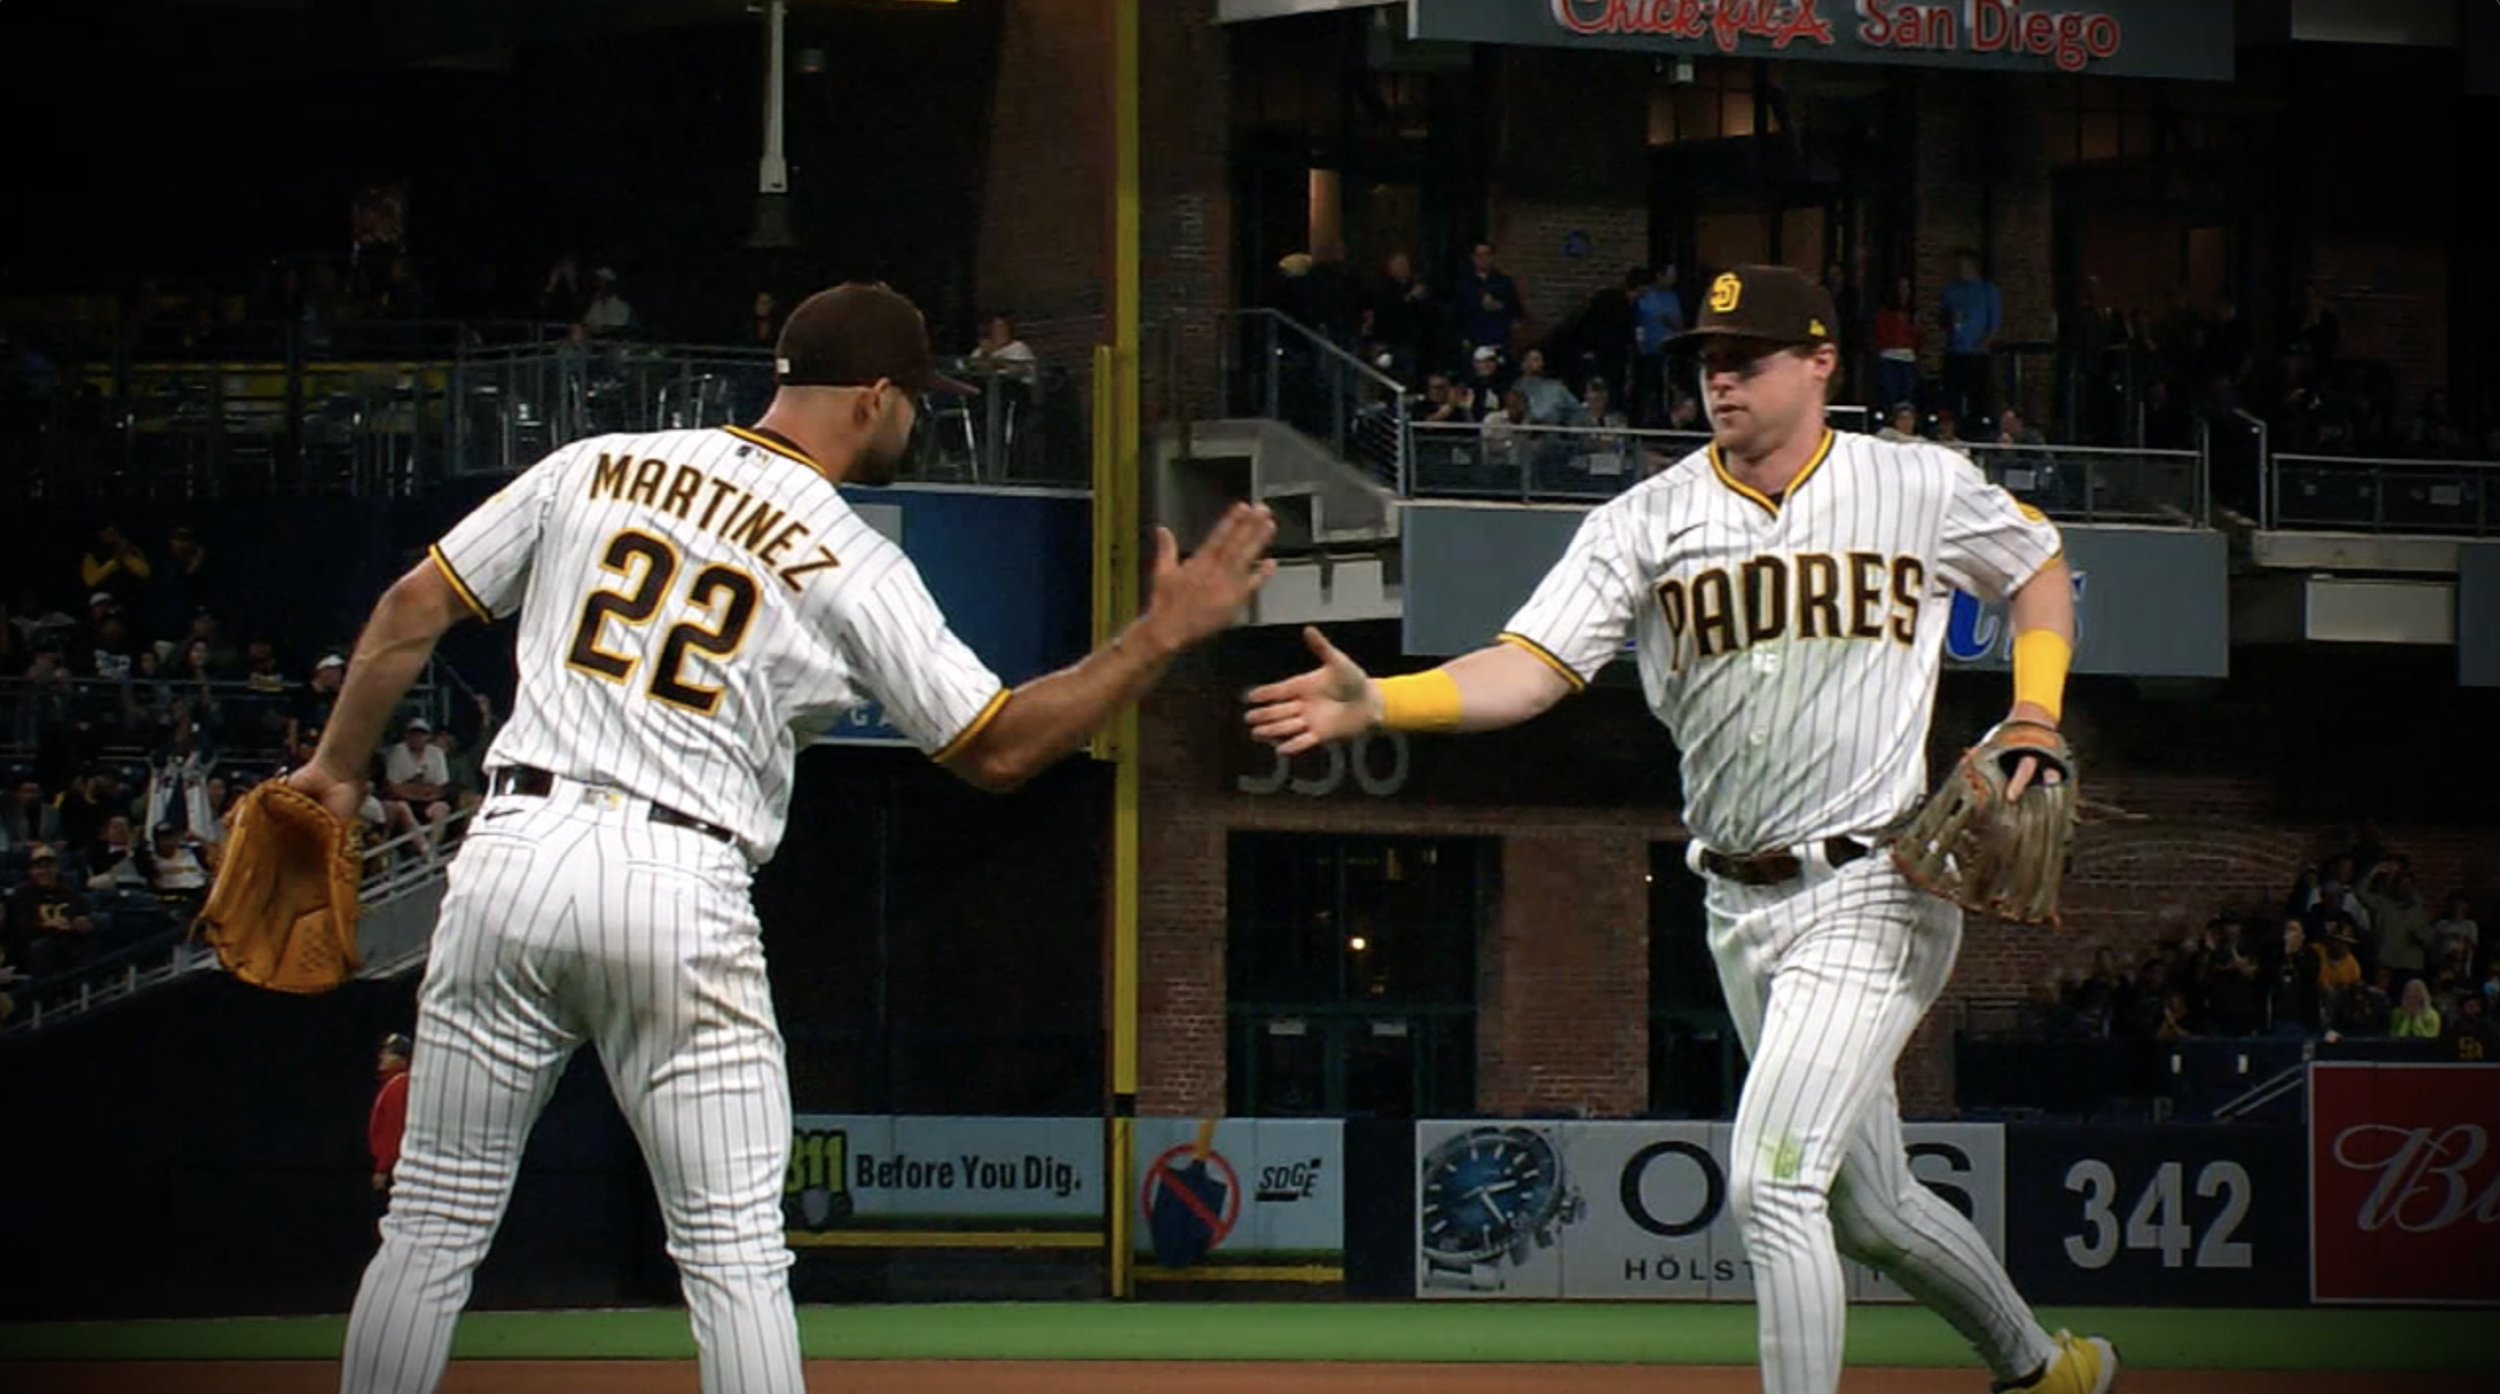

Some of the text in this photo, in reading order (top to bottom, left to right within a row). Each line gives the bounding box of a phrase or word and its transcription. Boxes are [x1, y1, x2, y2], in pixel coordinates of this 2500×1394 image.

[1858, 0, 1955, 50] San
[1967, 0, 2121, 70] Diego
[589, 453, 841, 592] MARTINEZ
[566, 527, 762, 717] 22
[1655, 551, 1925, 674] PADRES
[856, 1154, 954, 1189] Before
[961, 1155, 1015, 1189] You
[1023, 1155, 1082, 1197] Dig.
[2063, 1159, 2254, 1269] 342
